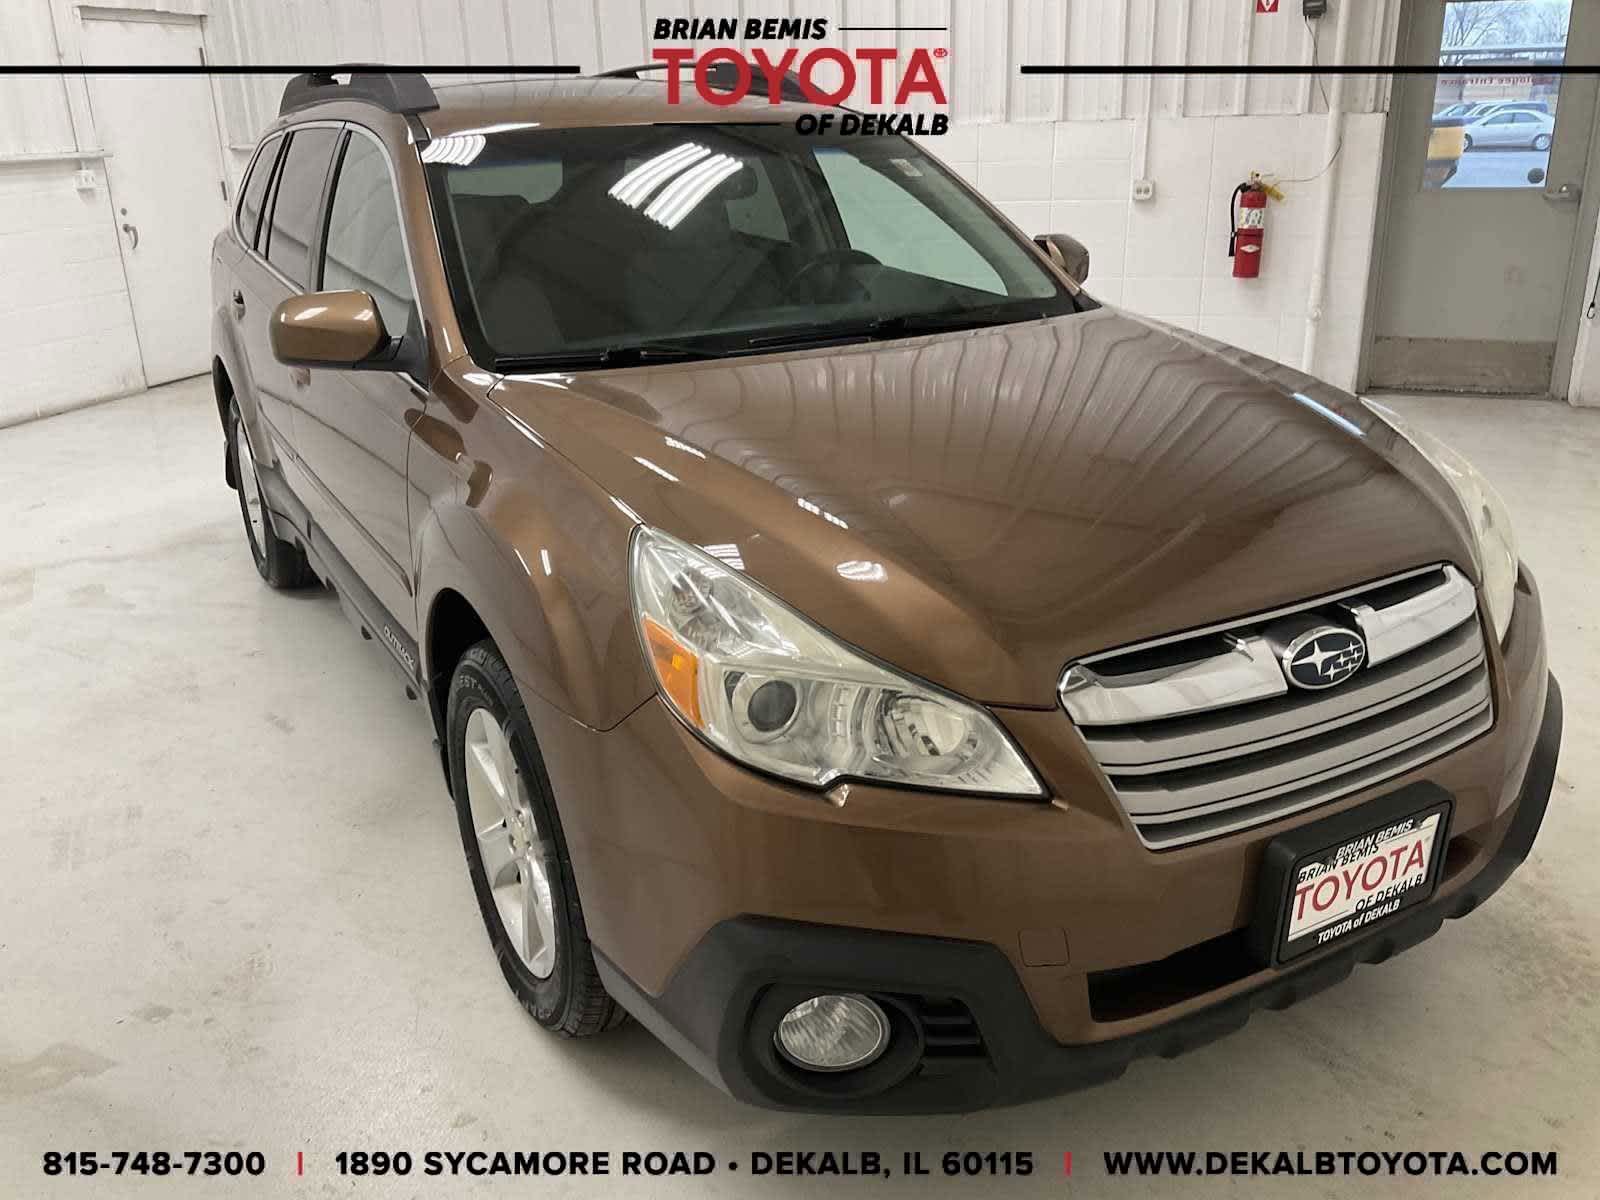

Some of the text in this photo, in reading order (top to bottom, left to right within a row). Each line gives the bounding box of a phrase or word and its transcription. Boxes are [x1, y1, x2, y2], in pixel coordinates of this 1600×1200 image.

[1335, 819, 1414, 860] BRIAN BEMIS
[1295, 839, 1425, 921] TOYOTA
[1299, 844, 1380, 882] BRIAN BEMIS
[1375, 873, 1424, 903] DEKALB
[1317, 898, 1401, 945] TOYOTA of DEKALB
